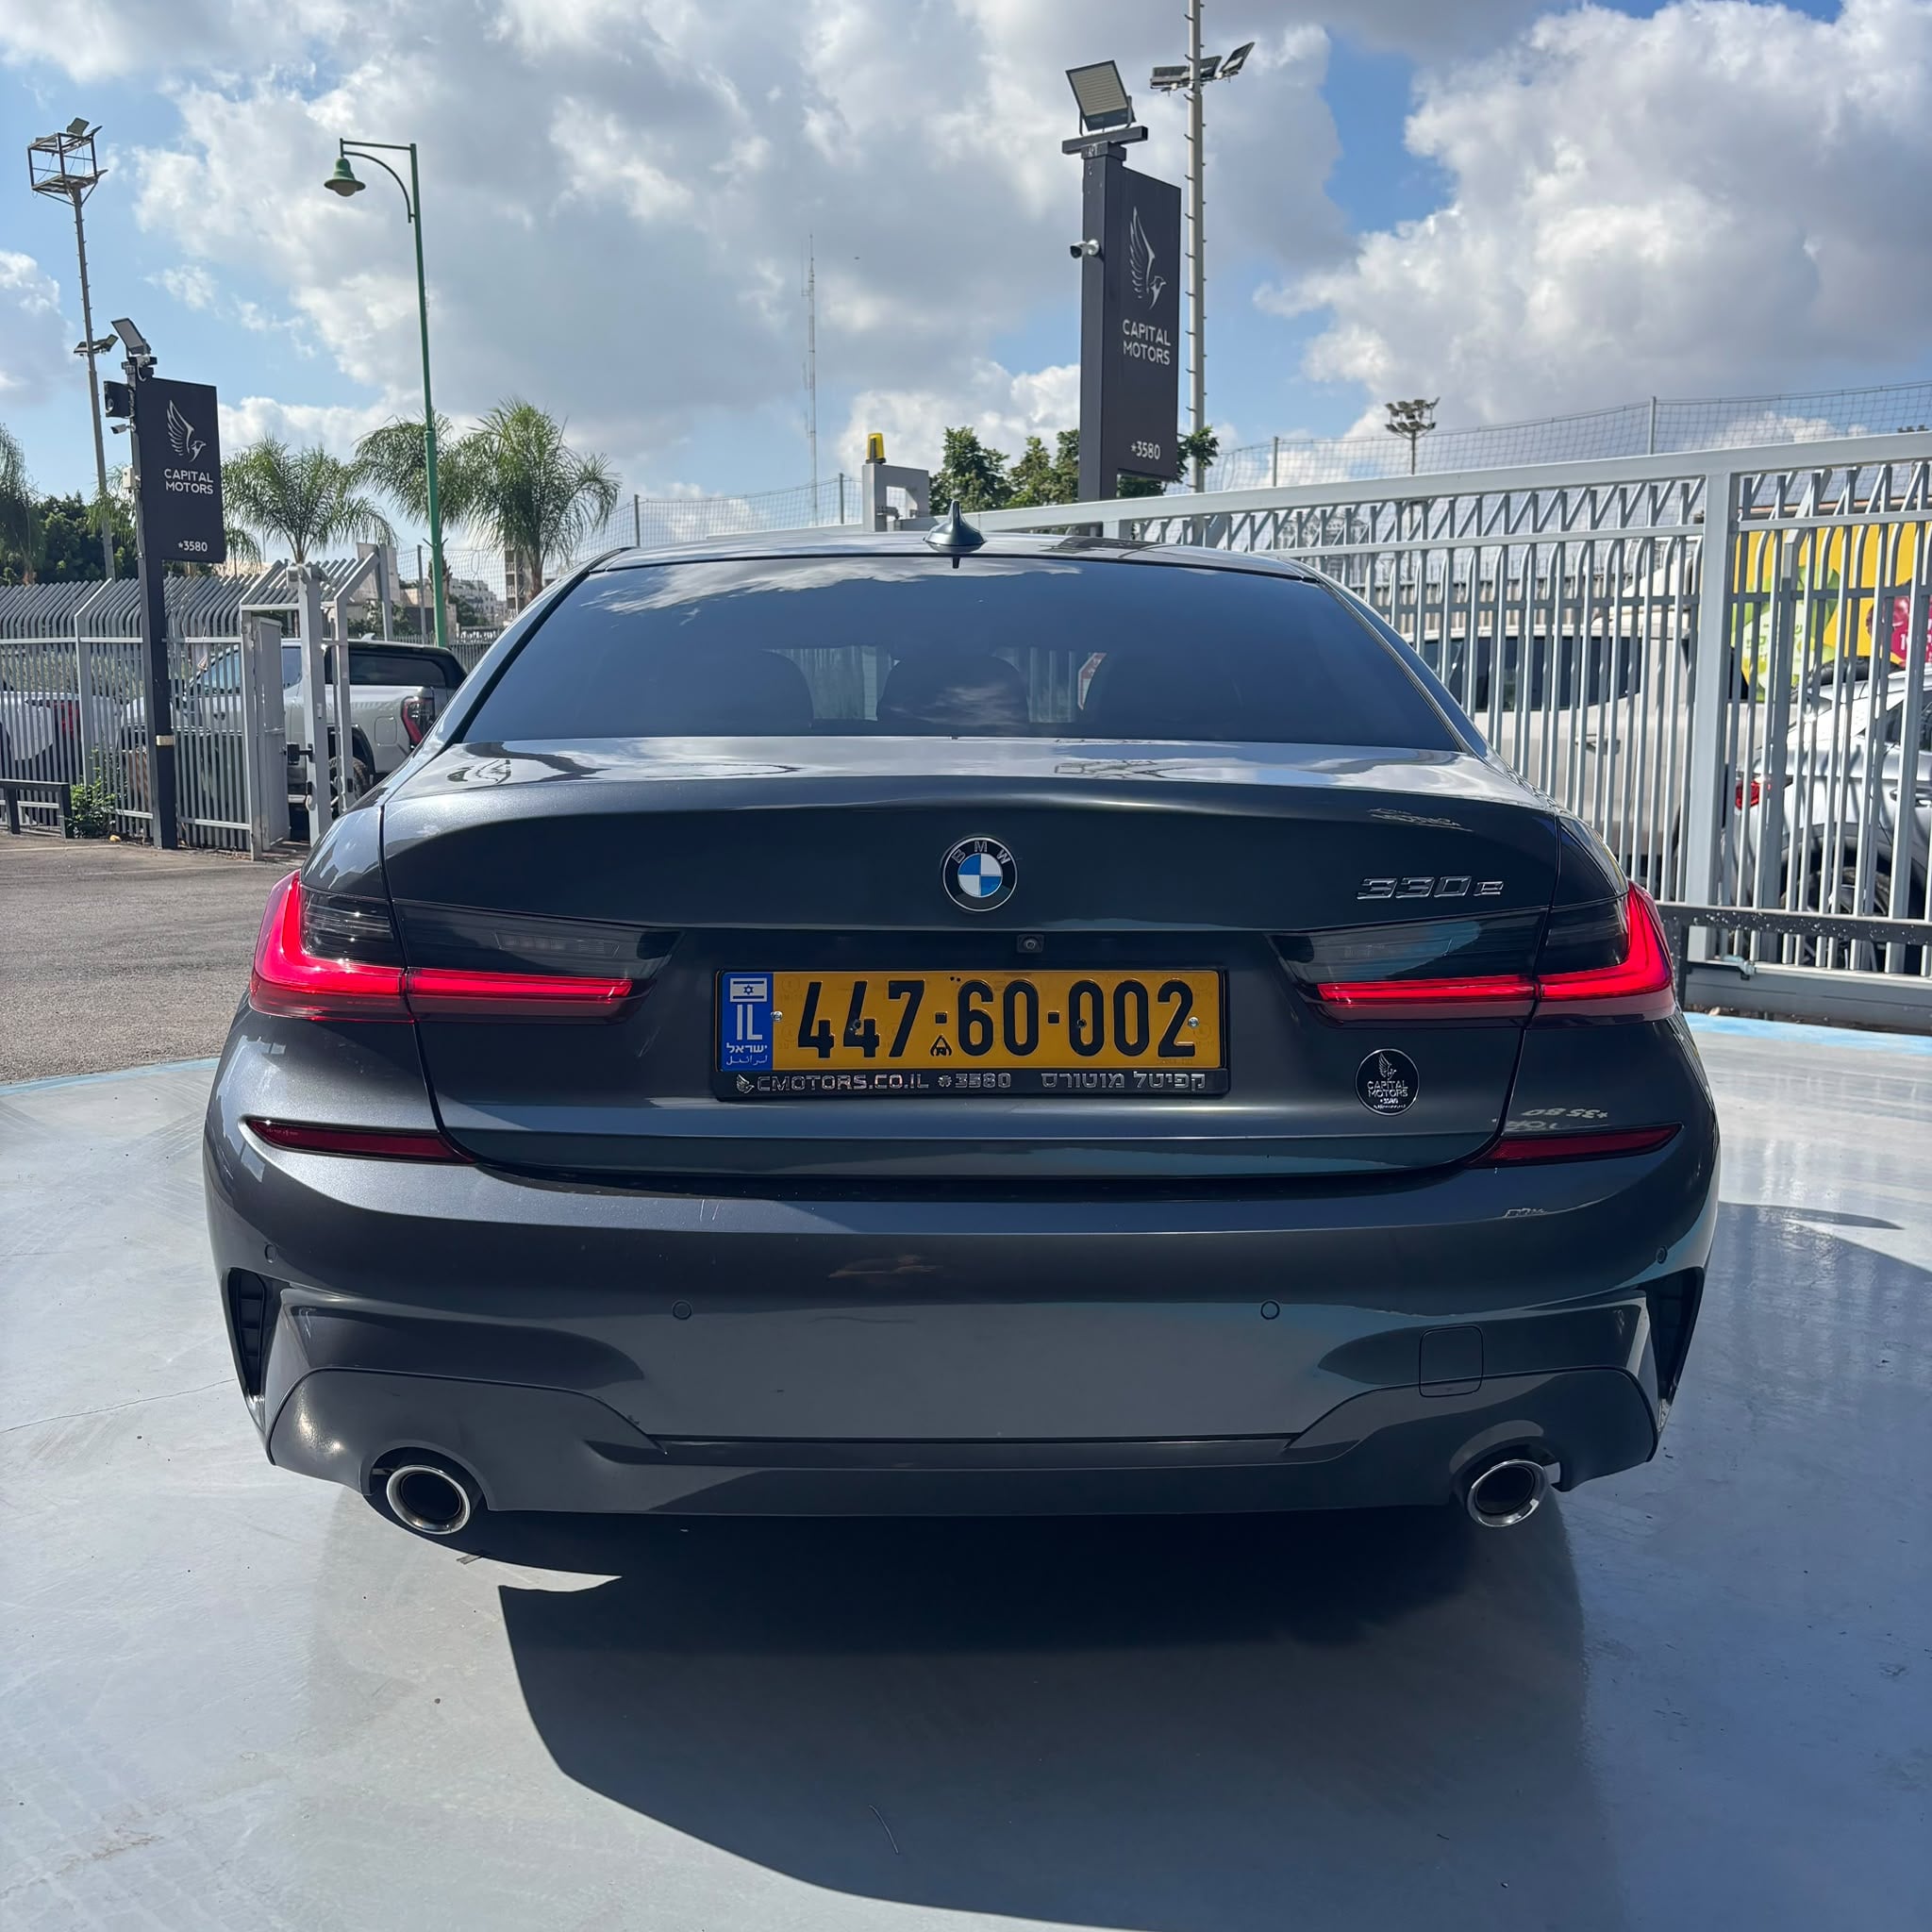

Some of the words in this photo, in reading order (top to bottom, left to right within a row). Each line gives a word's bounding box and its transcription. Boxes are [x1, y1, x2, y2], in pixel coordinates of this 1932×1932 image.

[1123, 319, 1171, 346] CAPITAL
[1123, 340, 1170, 365] MOTORS
[164, 468, 213, 483] CAPITAL
[165, 480, 213, 494] MOTORS
[951, 841, 1011, 864] BMW
[737, 1004, 763, 1041] IL
[725, 1041, 768, 1054] ישראל
[757, 1074, 929, 1091] CMOTORS.CO.IL
[1041, 1073, 1125, 1089] מוטורס
[1132, 1071, 1206, 1091] קפיטל
[1367, 1079, 1408, 1090] CAPITAL
[1368, 1089, 1408, 1097] MOTORS
